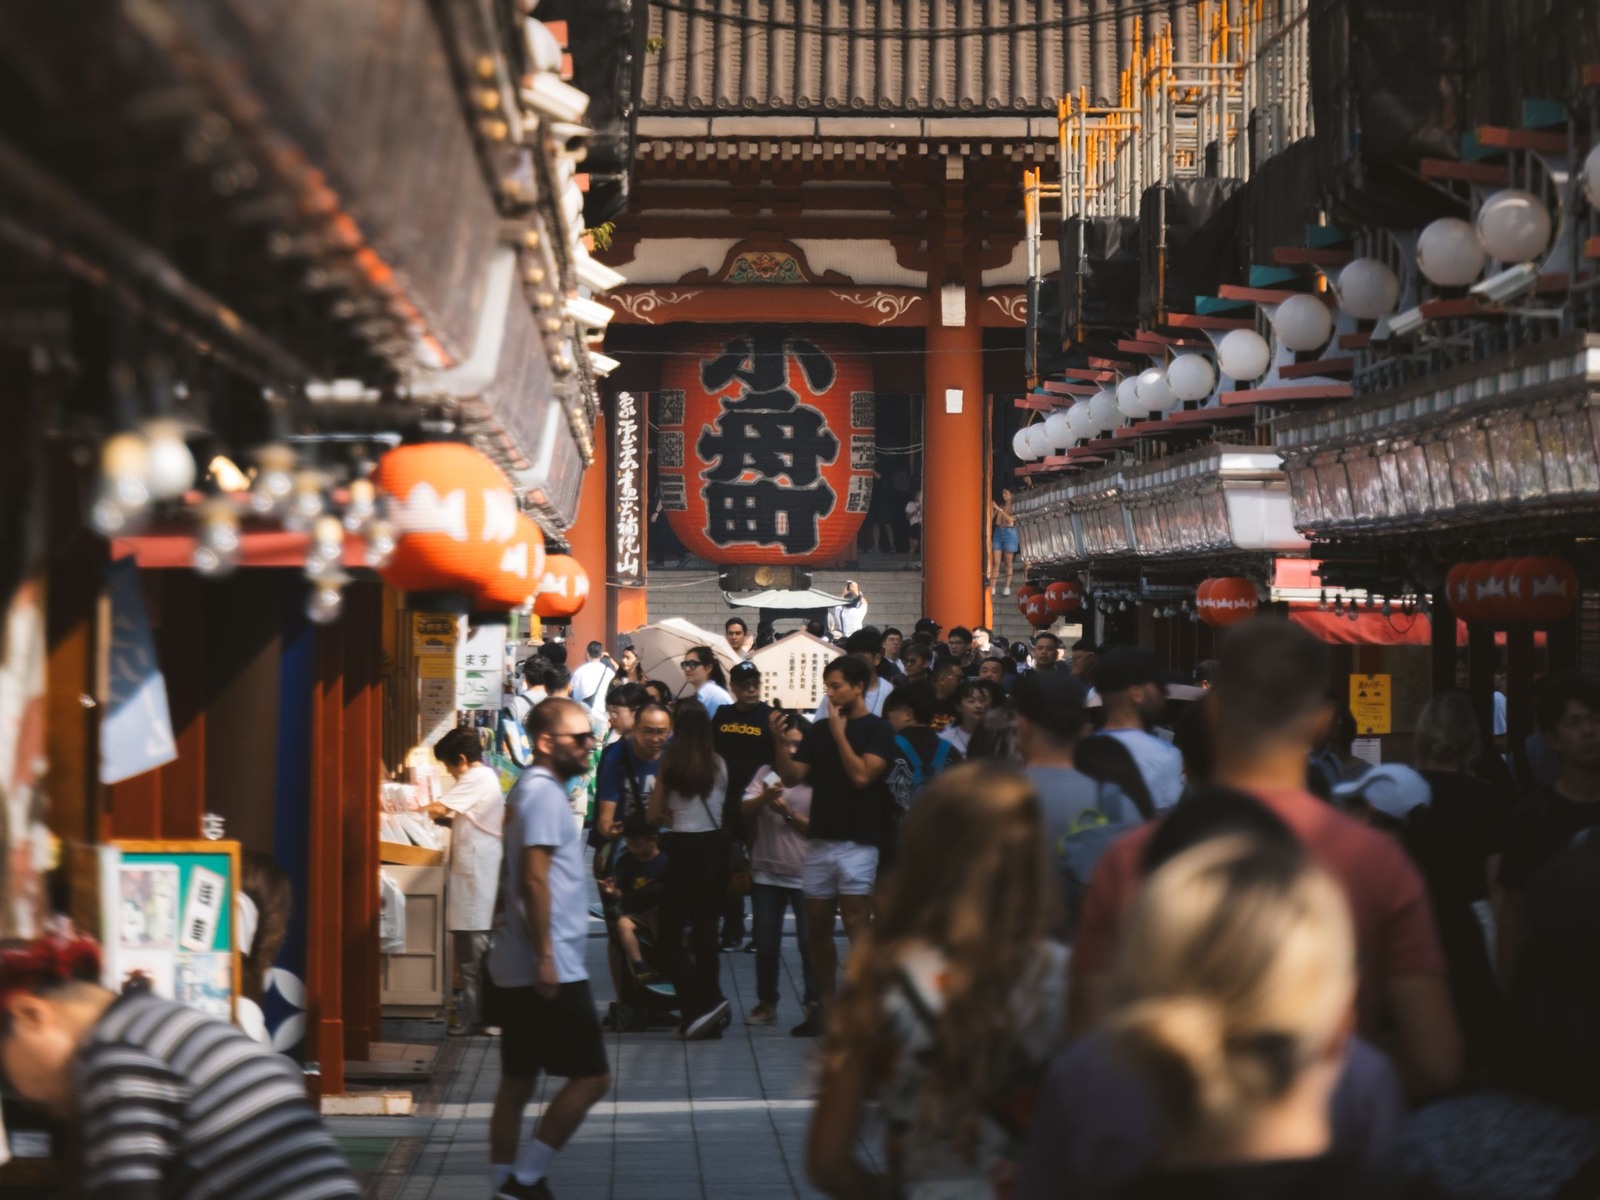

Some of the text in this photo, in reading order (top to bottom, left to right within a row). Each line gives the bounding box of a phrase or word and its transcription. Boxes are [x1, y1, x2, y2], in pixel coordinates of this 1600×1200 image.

[697, 337, 840, 555] 小舟町
[465, 654, 491, 666] ます
[720, 723, 762, 736] adidas
